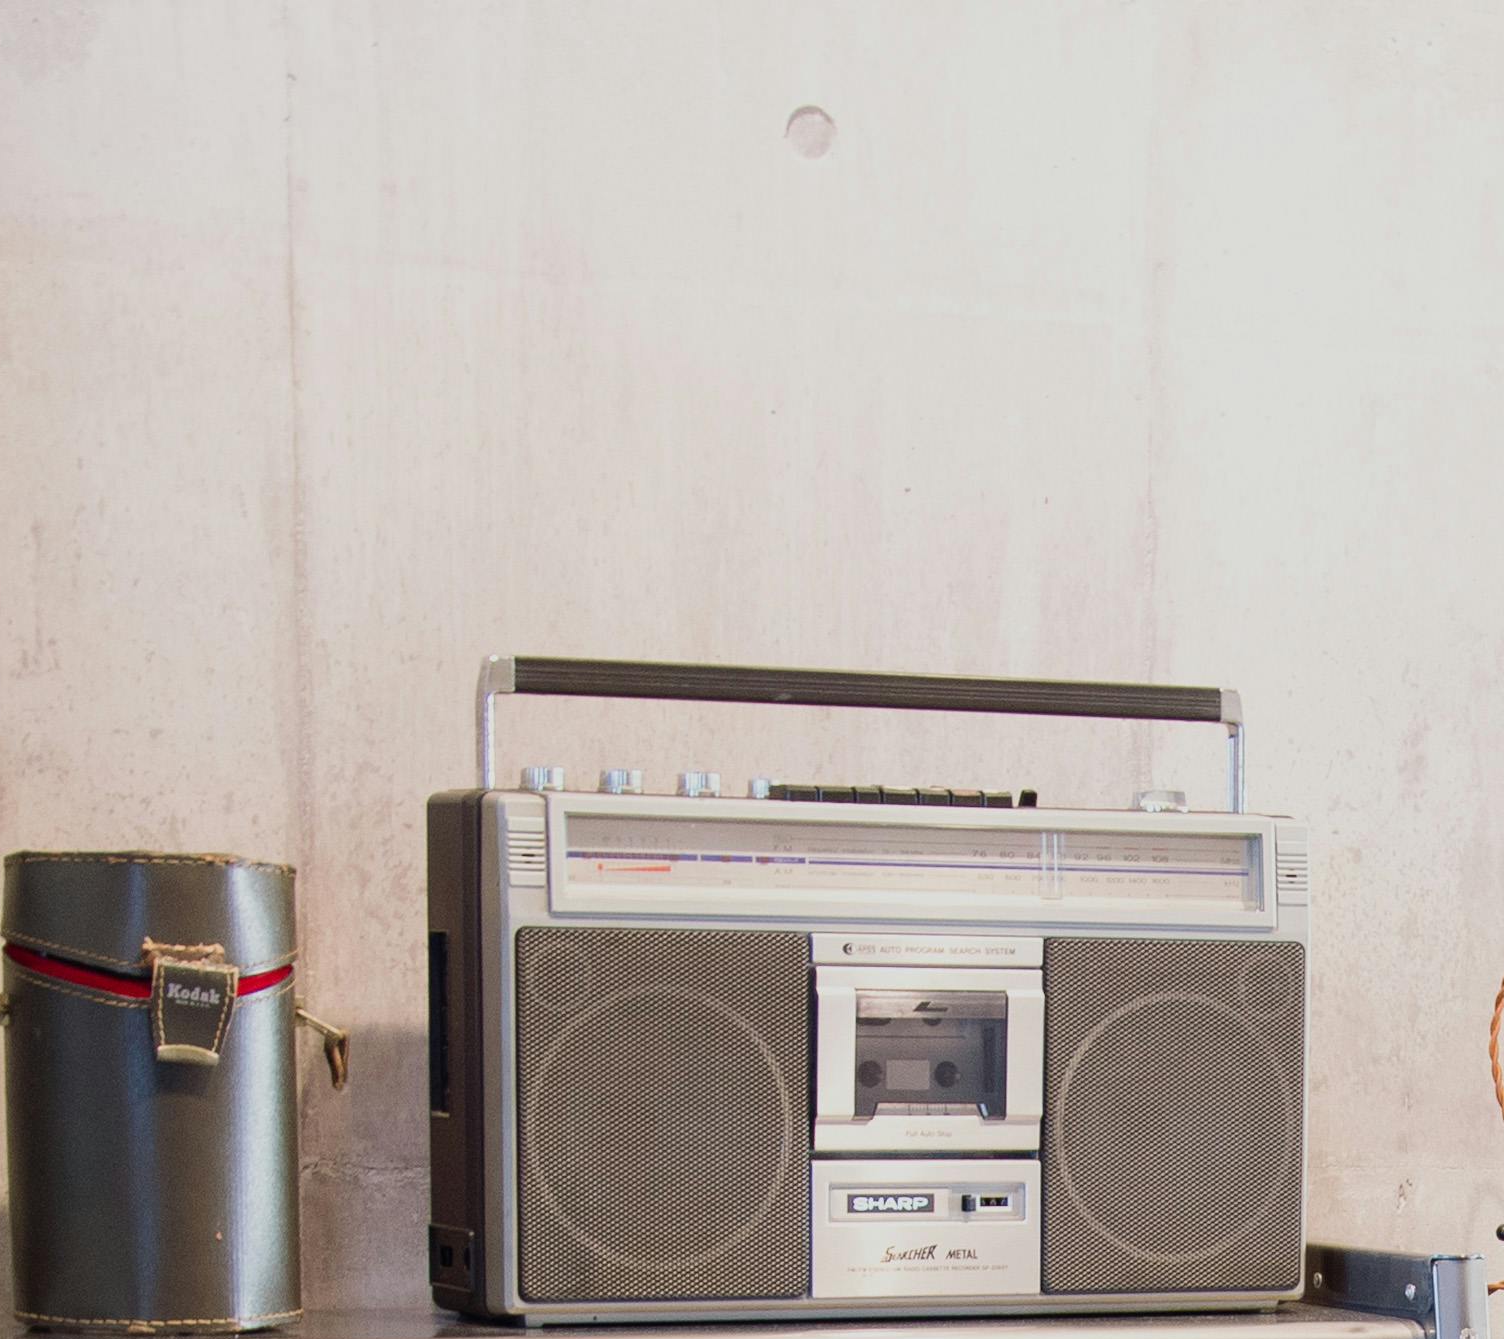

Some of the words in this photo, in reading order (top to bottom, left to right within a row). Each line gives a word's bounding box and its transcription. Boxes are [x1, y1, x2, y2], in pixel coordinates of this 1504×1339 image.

[167, 982, 221, 1005] Kodak
[852, 1196, 929, 1212] SHARP
[946, 1249, 979, 1260] METAL
